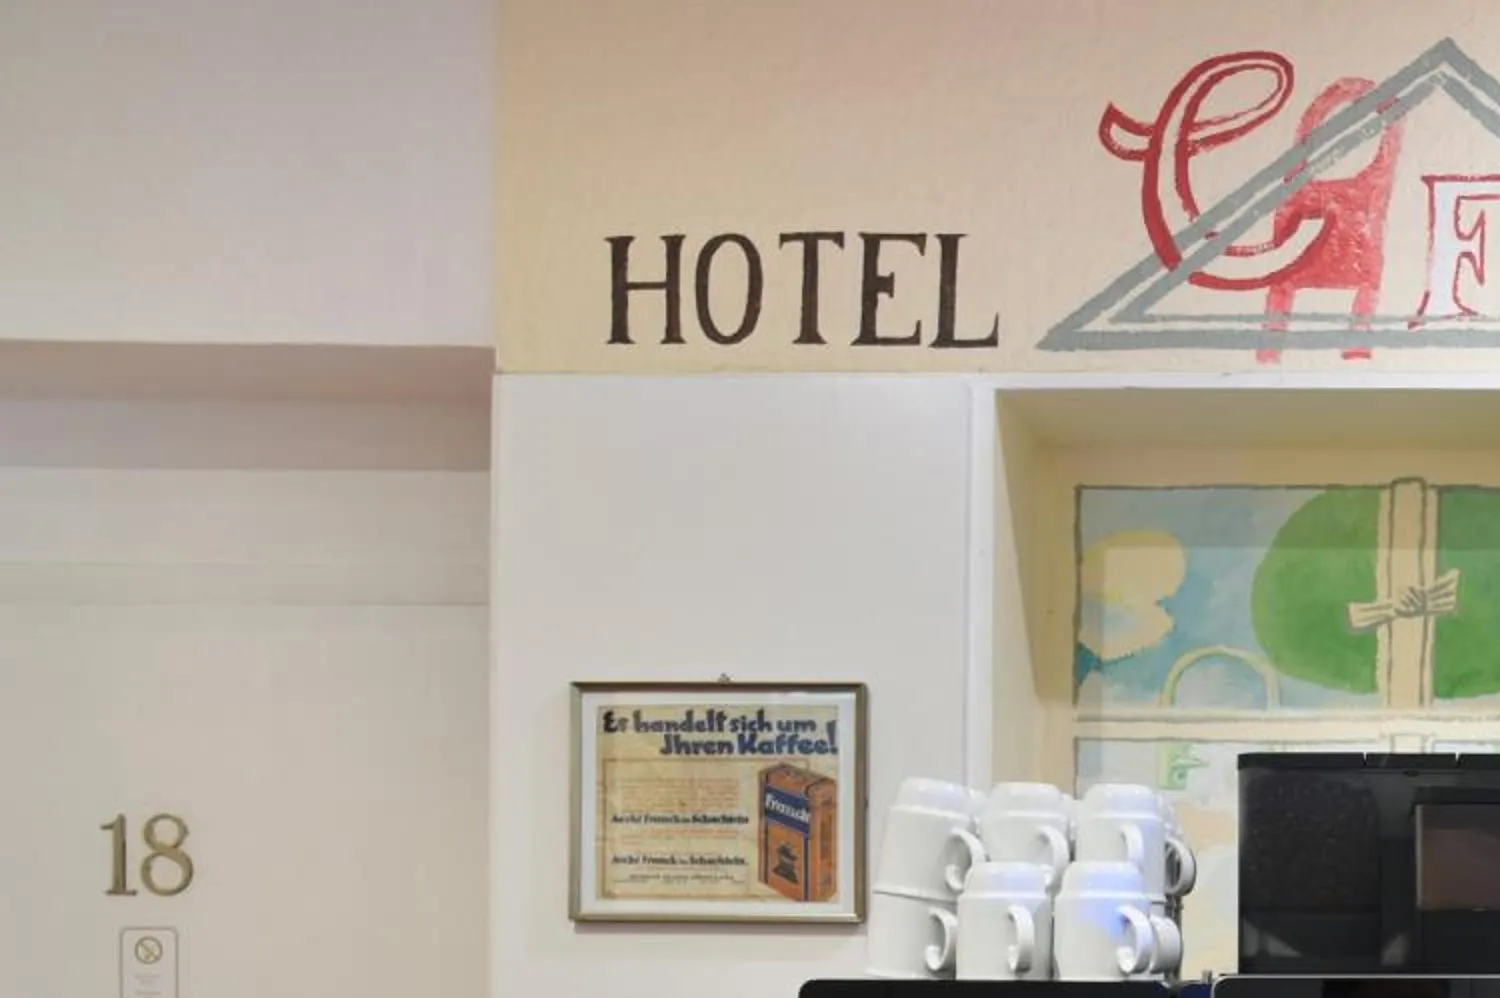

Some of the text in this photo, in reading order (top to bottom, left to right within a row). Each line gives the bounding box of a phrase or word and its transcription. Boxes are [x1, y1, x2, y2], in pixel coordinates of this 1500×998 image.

[604, 231, 999, 349] HOTEL
[632, 709, 727, 734] handelt
[729, 707, 772, 733] sich
[776, 719, 816, 733] um
[101, 813, 194, 897] 18
